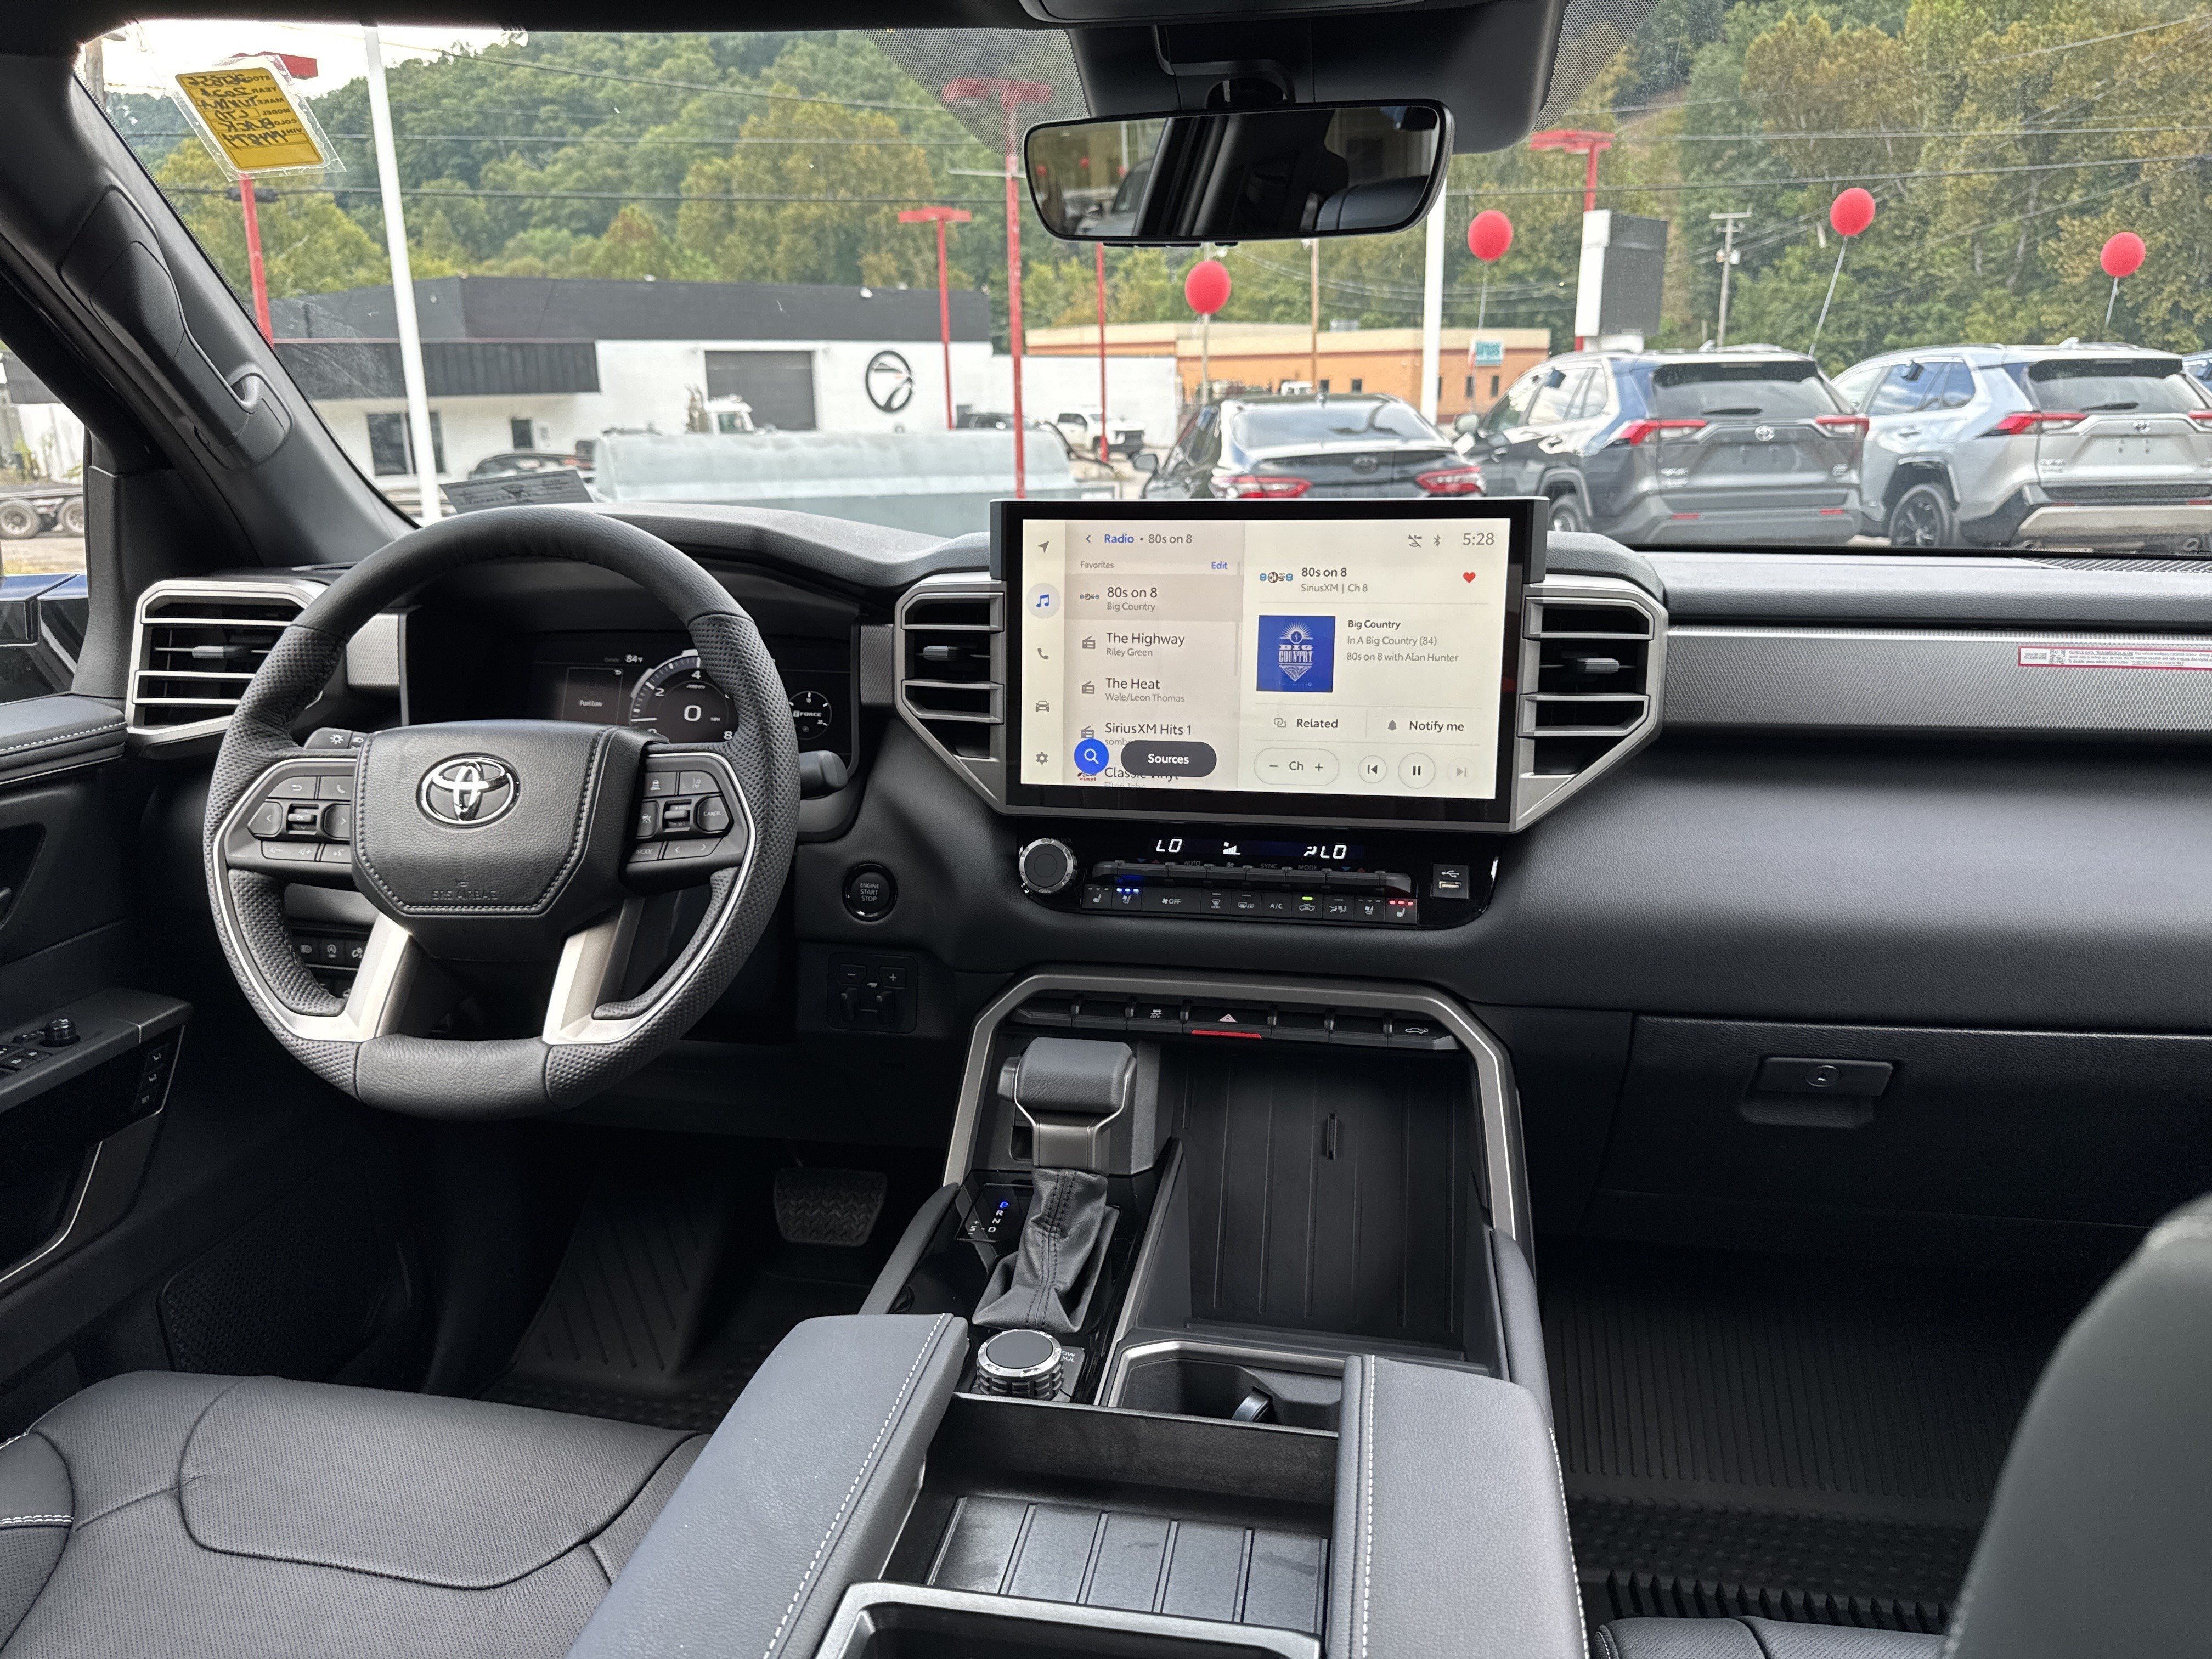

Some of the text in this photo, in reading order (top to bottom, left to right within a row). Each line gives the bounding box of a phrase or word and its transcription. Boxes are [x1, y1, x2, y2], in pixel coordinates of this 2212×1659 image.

[1104, 534, 1134, 544] Radio
[1148, 534, 1167, 544] 80s
[1186, 534, 1192, 544] 8
[1462, 532, 1494, 546] 5:28
[1211, 561, 1228, 569] Edit
[1301, 567, 1347, 577] 80s on 8
[1107, 586, 1158, 598] 80s on 8
[1301, 584, 1338, 592] SiriusXM
[1348, 584, 1361, 592] Ch
[1107, 602, 1155, 613] Big Country
[1348, 620, 1401, 630] Big Country
[1106, 633, 1185, 647] The Highway
[1347, 636, 1356, 645] In
[1366, 636, 1380, 646] Big
[1382, 636, 1417, 646] Country
[1419, 636, 1437, 646] (84)
[1106, 648, 1153, 657] Riley Green
[1278, 651, 1313, 663] COUNTRY
[1346, 652, 1362, 661] 80s
[1384, 653, 1403, 661] with
[1404, 653, 1425, 661] Alan
[1427, 653, 1459, 662] Hunter
[691, 670, 702, 679] 4
[1105, 678, 1160, 689] The Heat
[655, 688, 665, 697] 2
[1105, 692, 1185, 702] Wale/Leon Thomas
[684, 705, 702, 721] 0
[1105, 723, 1192, 735] SiriusXM Hits 1
[1296, 719, 1338, 729] Related
[1409, 721, 1465, 733] Notify me
[723, 731, 733, 740] 8
[1148, 753, 1189, 764] Sources
[1289, 761, 1304, 771] Ch
[1156, 839, 1182, 852] LO
[1320, 845, 1347, 859] LO
